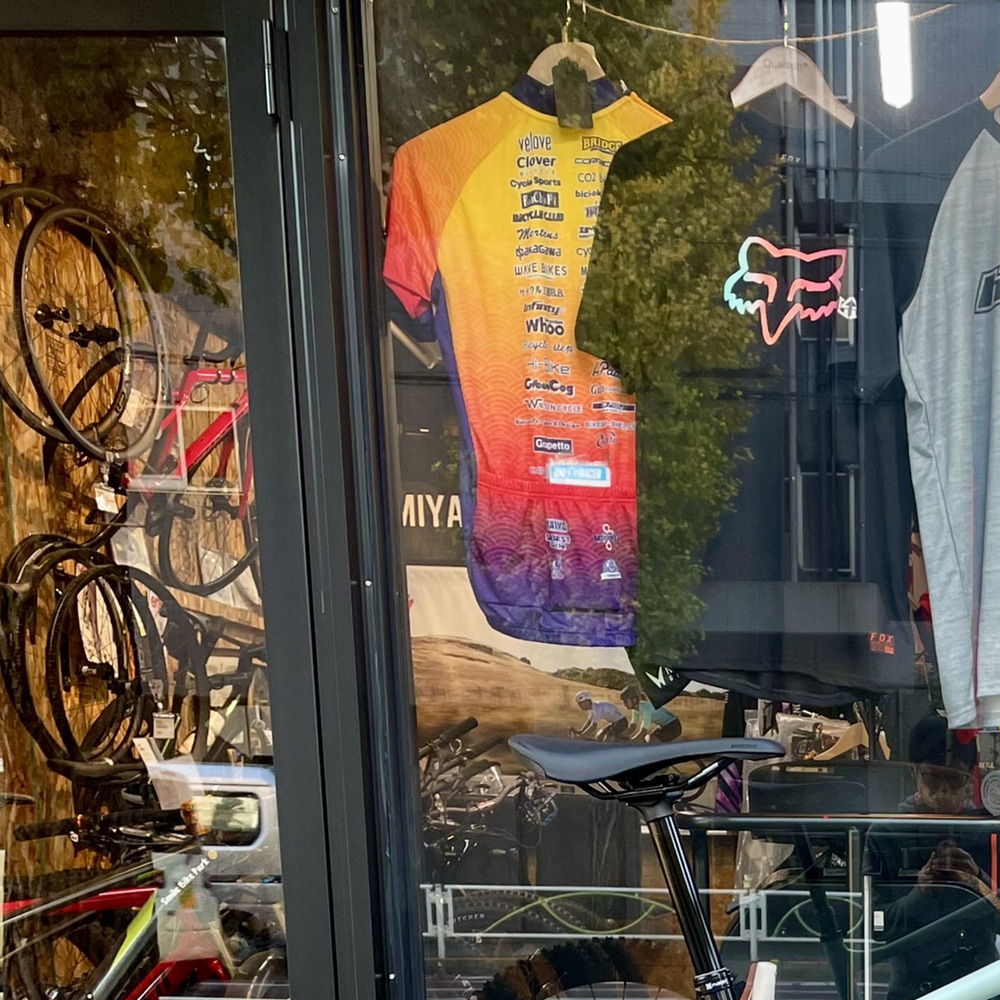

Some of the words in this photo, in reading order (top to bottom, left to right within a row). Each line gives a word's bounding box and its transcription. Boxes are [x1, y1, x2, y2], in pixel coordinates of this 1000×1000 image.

[518, 132, 552, 152] velove
[516, 156, 556, 169] Clover
[534, 176, 561, 186] Sports
[514, 262, 537, 277] WAVE
[541, 262, 567, 277] BIKES
[526, 316, 565, 336] Whoo
[869, 632, 895, 643] FOX
[177, 867, 196, 894] Bike
[191, 857, 210, 878] Park
